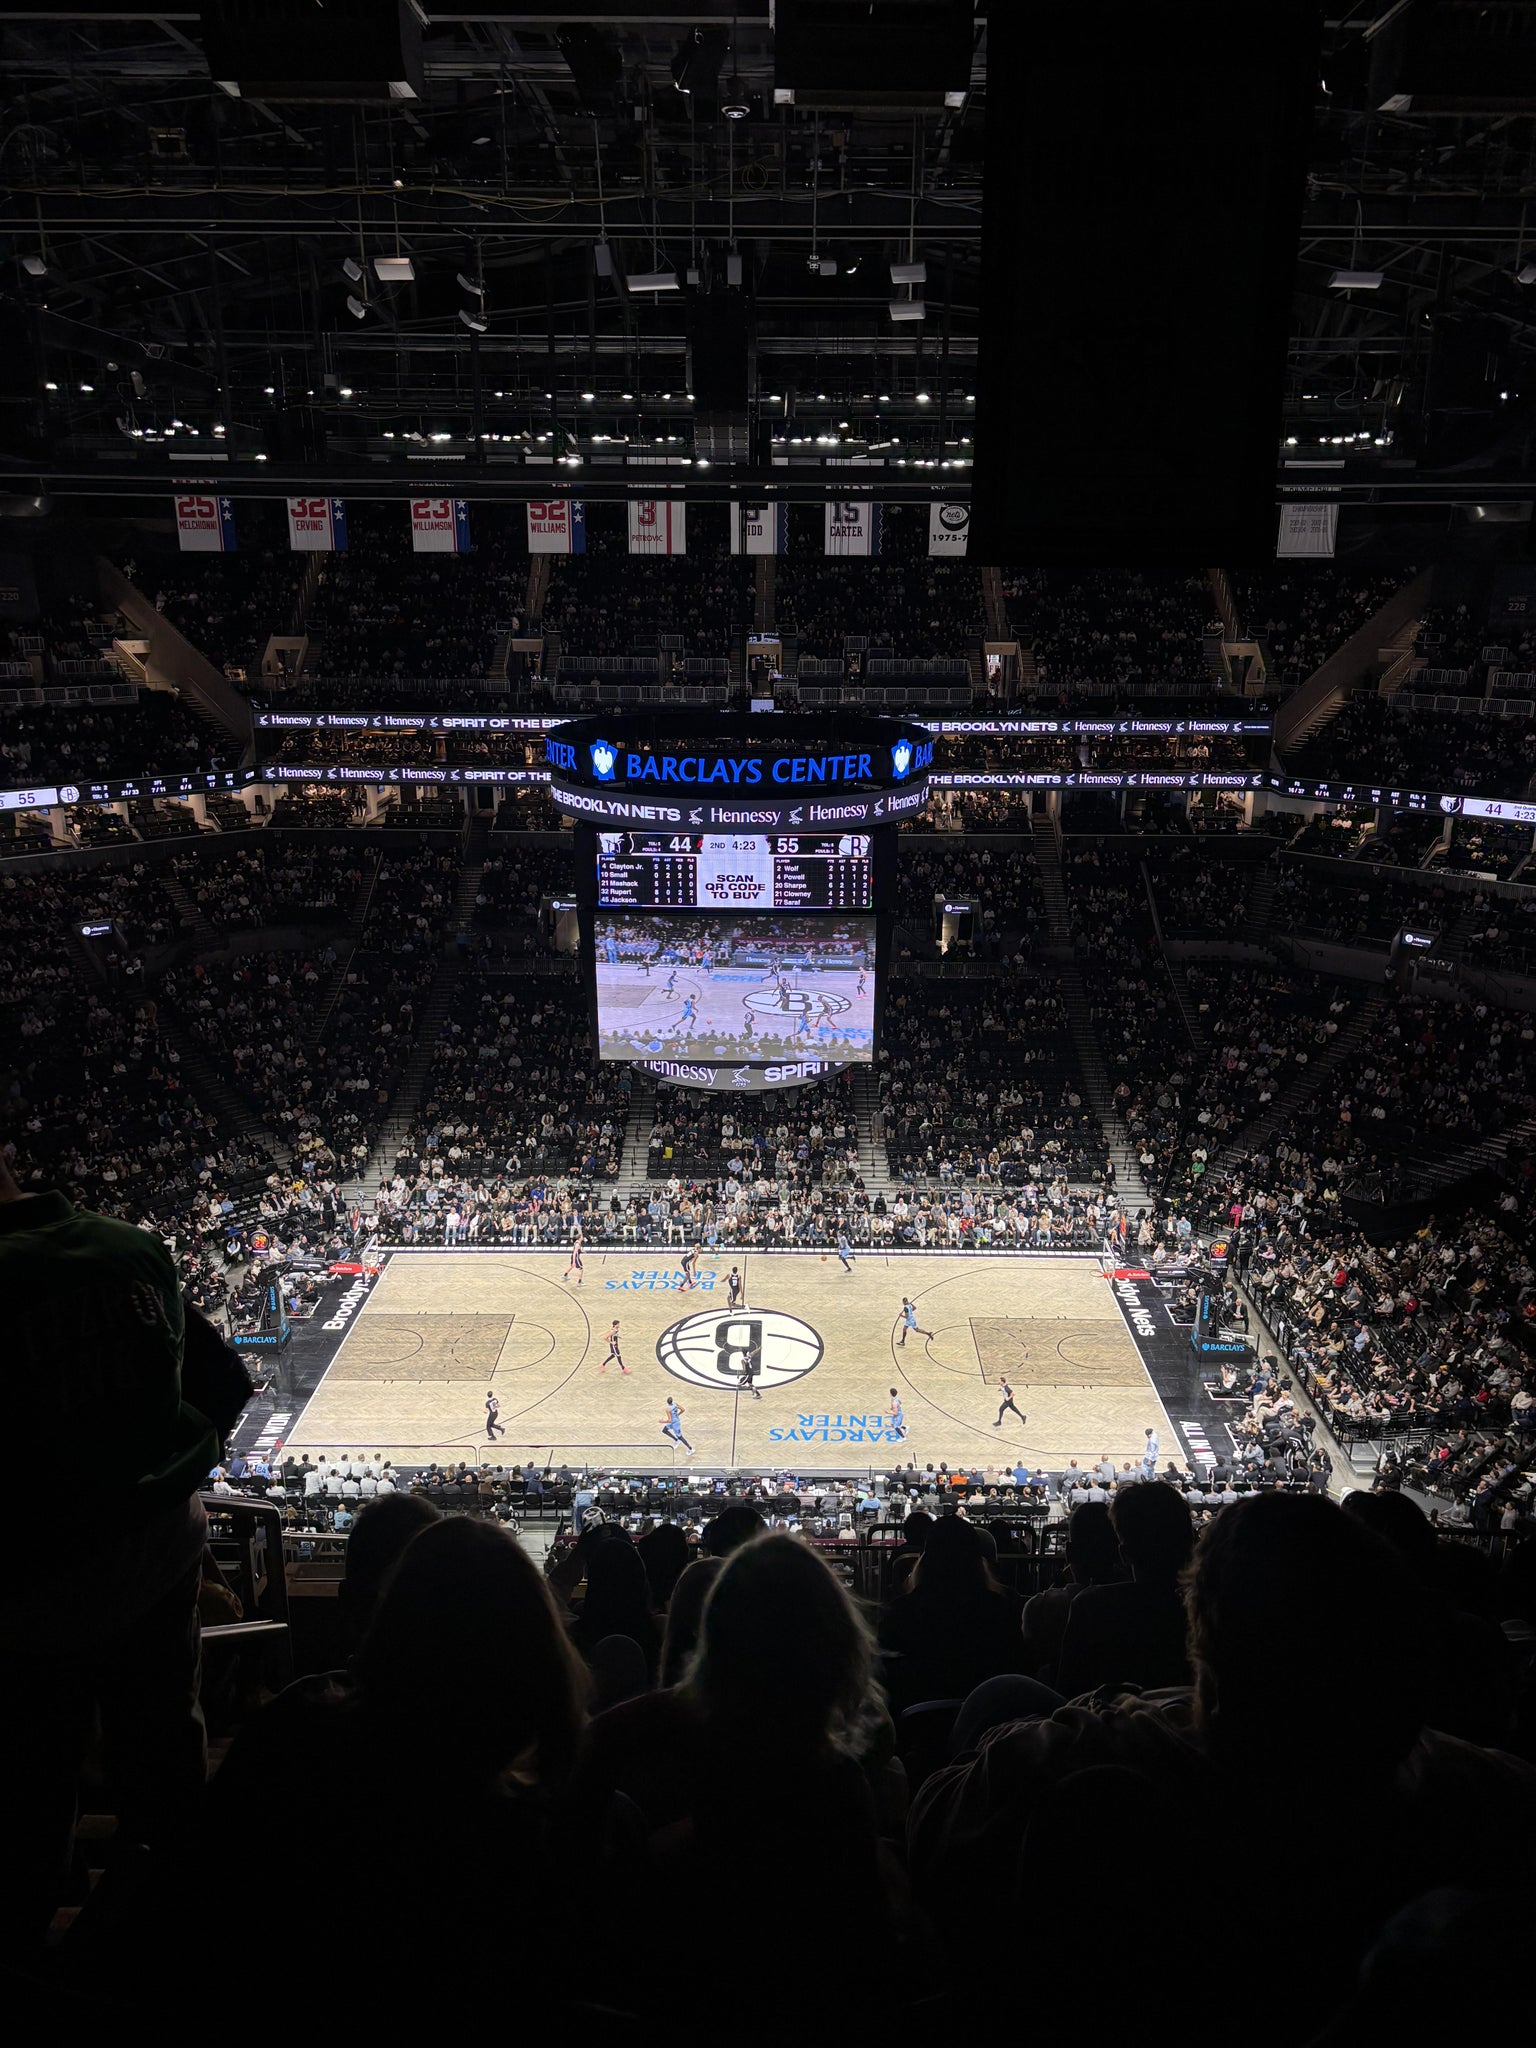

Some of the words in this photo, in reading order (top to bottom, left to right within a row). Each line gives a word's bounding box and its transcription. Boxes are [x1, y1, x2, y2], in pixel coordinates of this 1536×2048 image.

[178, 497, 215, 518] 25
[290, 498, 327, 518] 32
[413, 500, 450, 519] 23
[638, 499, 657, 526] 3
[834, 500, 859, 523] 15
[296, 520, 323, 531] ERVING
[413, 522, 452, 531] WILLIAMSON
[531, 523, 567, 533] WILLIAMS
[743, 525, 763, 536] IDD
[830, 526, 863, 537] CARTER
[272, 715, 312, 726] Hennessy
[329, 716, 368, 726] Hennessy
[385, 716, 425, 728] Hennessy
[442, 719, 487, 728] SPIRIT
[490, 719, 510, 728] OF
[512, 719, 540, 728] THE
[942, 723, 1019, 731] BROOKLYN
[1021, 723, 1057, 731] NETS
[1075, 722, 1115, 733] Hennessy
[1132, 722, 1172, 732] Hennessy
[1189, 722, 1229, 732] Hennessy
[279, 768, 323, 778] Hennessy
[340, 768, 384, 780] Hennessy
[403, 769, 446, 780] Hennessy
[465, 772, 505, 780] SPIRIT
[508, 772, 526, 780] OF
[528, 772, 551, 781] THE
[627, 753, 762, 786] BARCLAYS
[772, 754, 872, 783] CENTER
[928, 775, 952, 784] THE
[954, 775, 1025, 783] BROOKLYN
[1027, 775, 1061, 783] NETS
[1079, 774, 1123, 785] Hennessy
[1141, 774, 1185, 785] Hennessy
[1203, 774, 1247, 785] Hennessy
[18, 792, 35, 804] 55
[563, 791, 629, 816] BROOKLYN
[632, 807, 680, 821] NETS
[711, 807, 781, 826] Hennessy
[810, 804, 869, 821] Hennessy
[888, 792, 920, 812] Hennessy
[1485, 804, 1502, 815] 44
[1514, 810, 1535, 820] 4:23
[670, 837, 691, 851] 44
[732, 841, 756, 850] 4:23
[777, 838, 799, 853] 55
[1129, 1308, 1155, 1336] Nets
[243, 1336, 277, 1344] BARCLAYS
[714, 1320, 762, 1376] B
[1210, 1344, 1245, 1352] BARCLAYS
[769, 1428, 900, 1442] BARCLAYS
